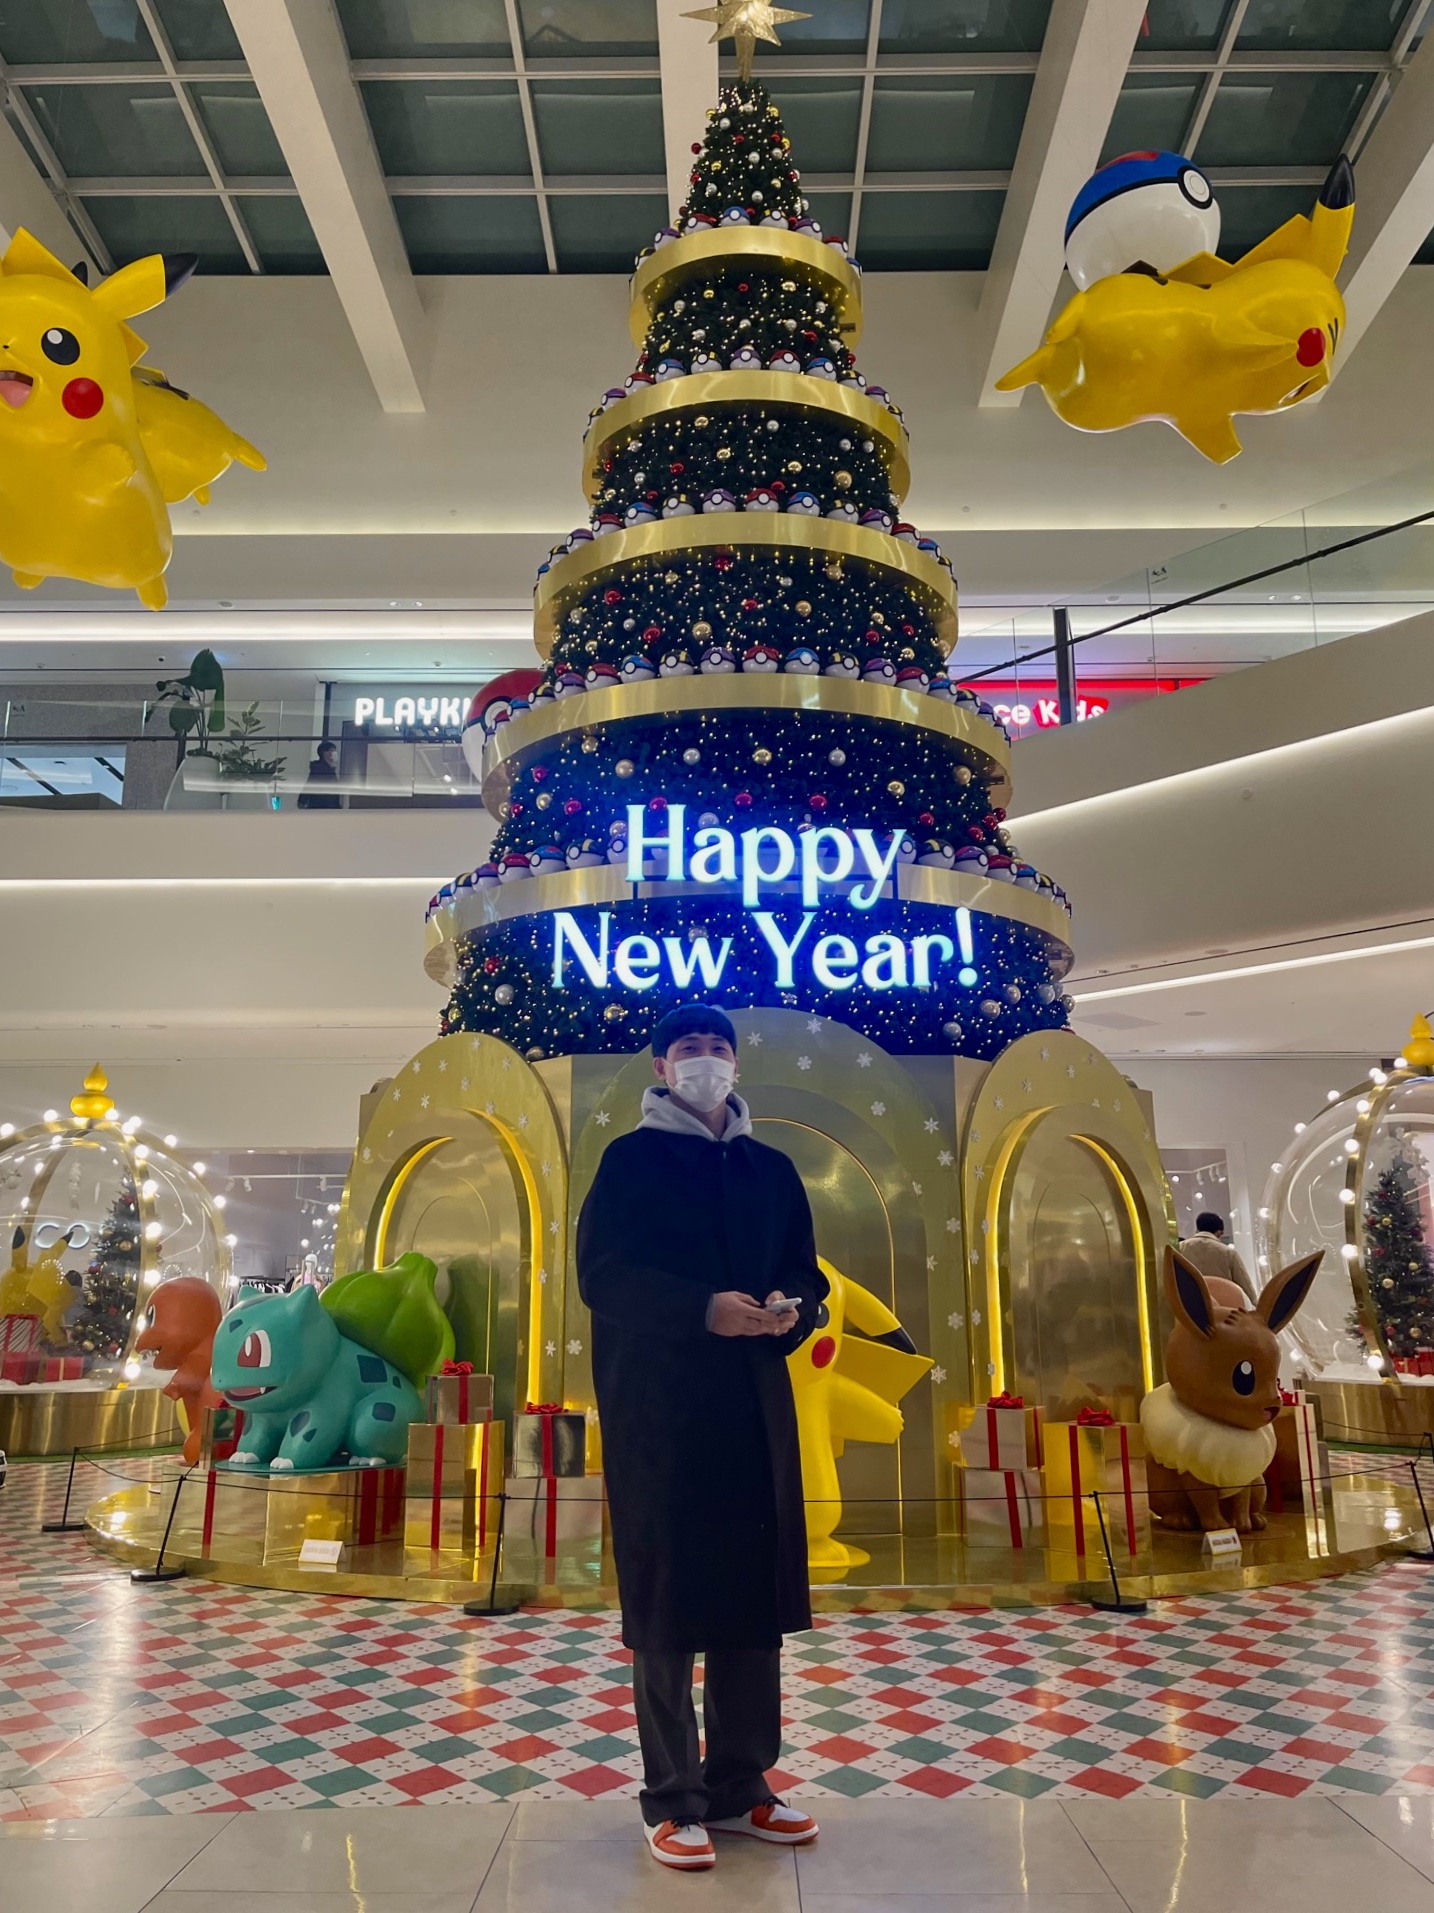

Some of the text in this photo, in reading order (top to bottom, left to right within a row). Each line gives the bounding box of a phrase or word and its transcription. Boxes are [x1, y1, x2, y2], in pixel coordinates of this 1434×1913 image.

[1038, 699, 1105, 724] Kds
[626, 804, 903, 910] Happy
[551, 906, 978, 989] New Year!
